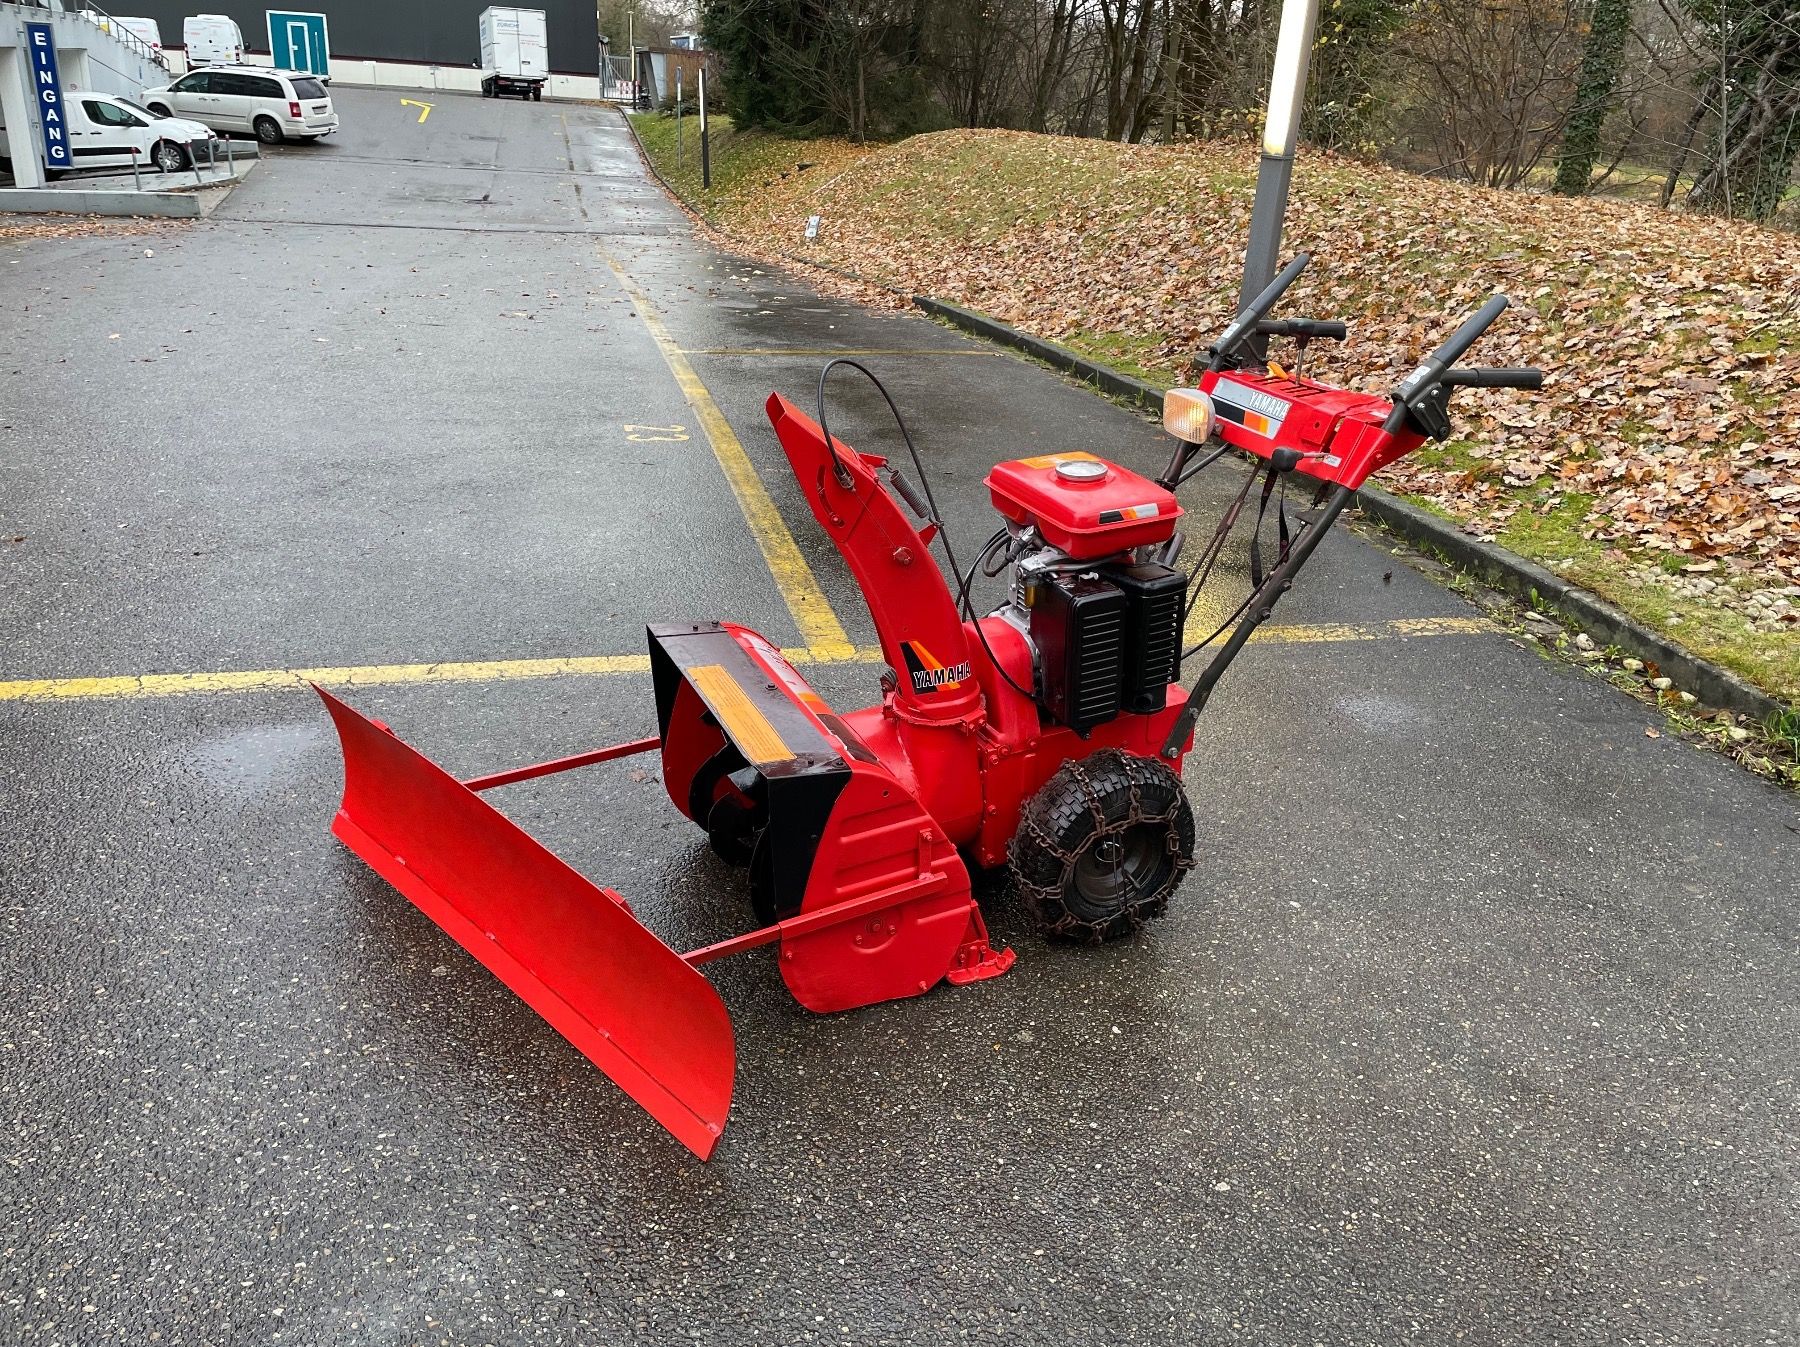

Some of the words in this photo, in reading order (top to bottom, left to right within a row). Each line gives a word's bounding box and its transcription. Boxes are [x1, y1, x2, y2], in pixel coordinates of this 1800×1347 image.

[33, 31, 65, 159] EINGANG
[1248, 391, 1292, 420] YAMAHA
[912, 659, 972, 689] YAMAHA
